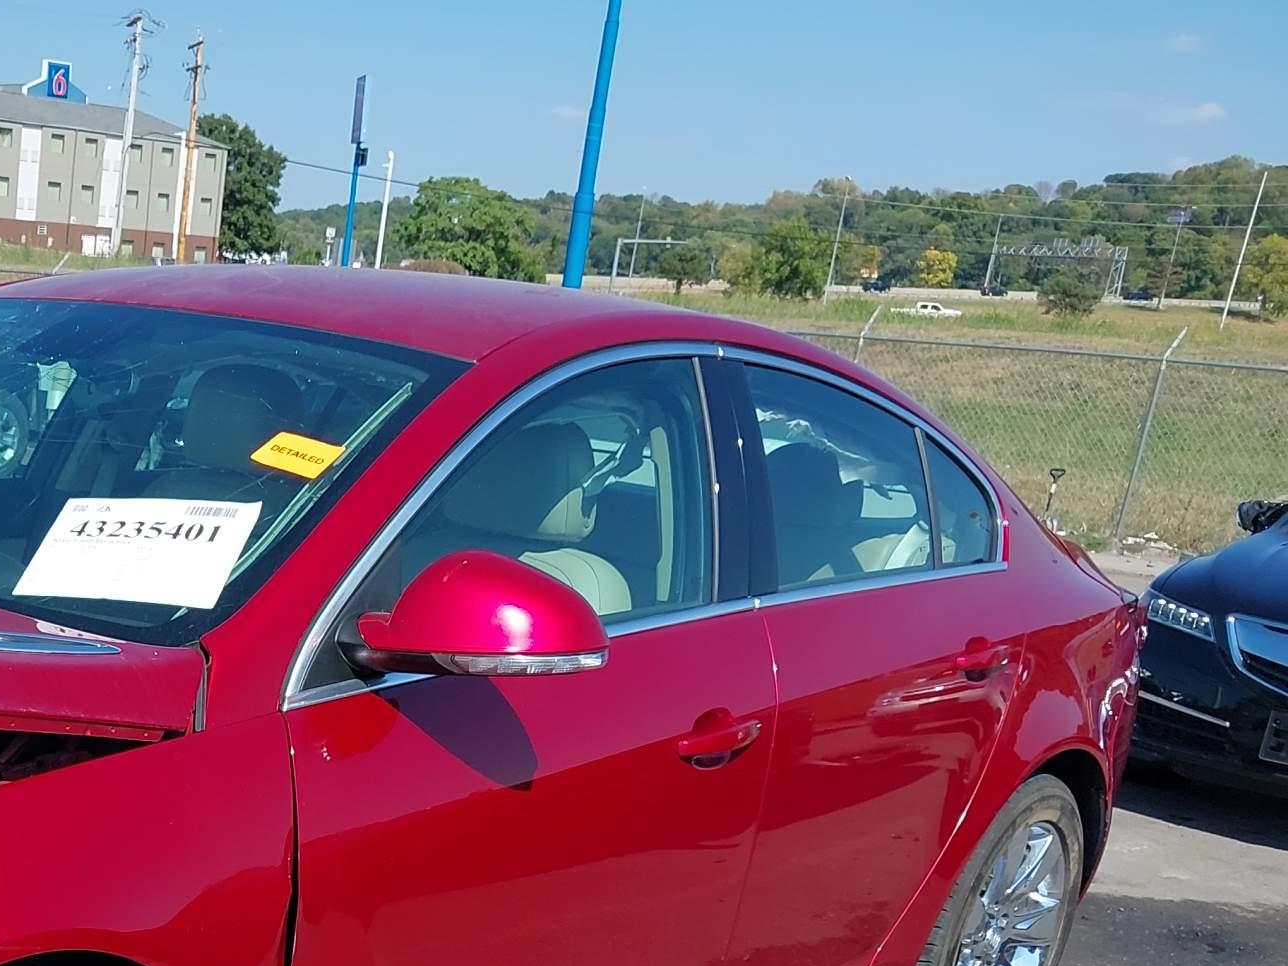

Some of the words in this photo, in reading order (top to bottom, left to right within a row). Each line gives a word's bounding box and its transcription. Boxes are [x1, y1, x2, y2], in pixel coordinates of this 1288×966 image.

[52, 68, 67, 96] 6
[270, 444, 325, 465] DETAILED
[70, 519, 222, 543] 43235401
